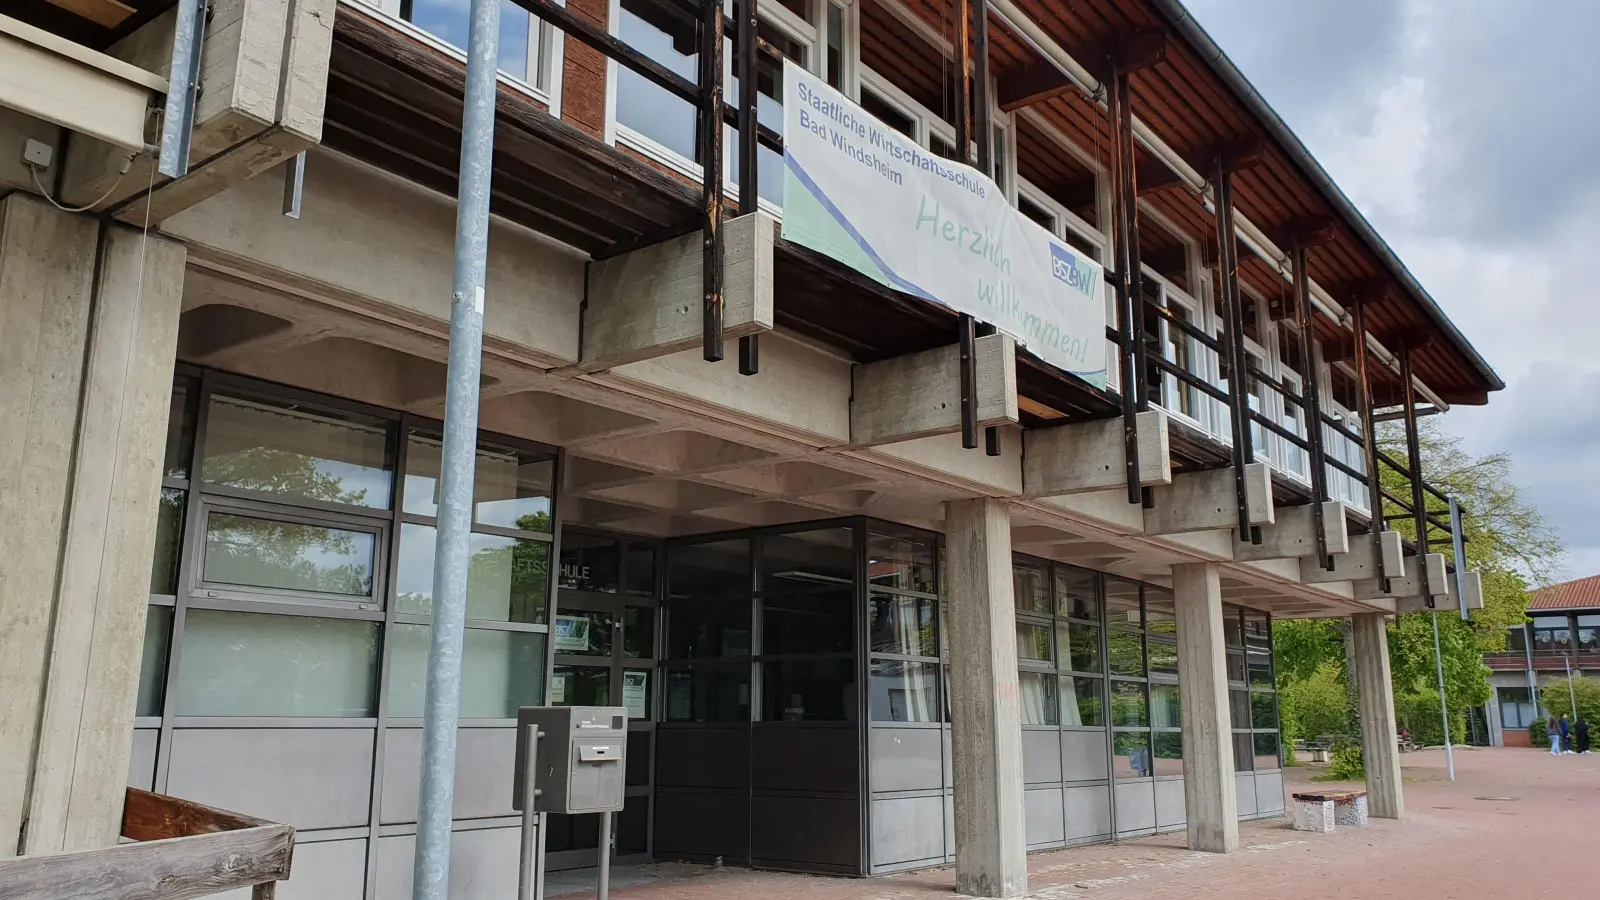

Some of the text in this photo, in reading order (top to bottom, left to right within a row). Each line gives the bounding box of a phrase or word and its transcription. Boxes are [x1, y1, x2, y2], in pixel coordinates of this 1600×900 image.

[797, 82, 986, 199] Staatliche Wirtschaftsschule
[799, 109, 903, 186] Bad Windsheim
[915, 193, 1011, 276] Herzlich
